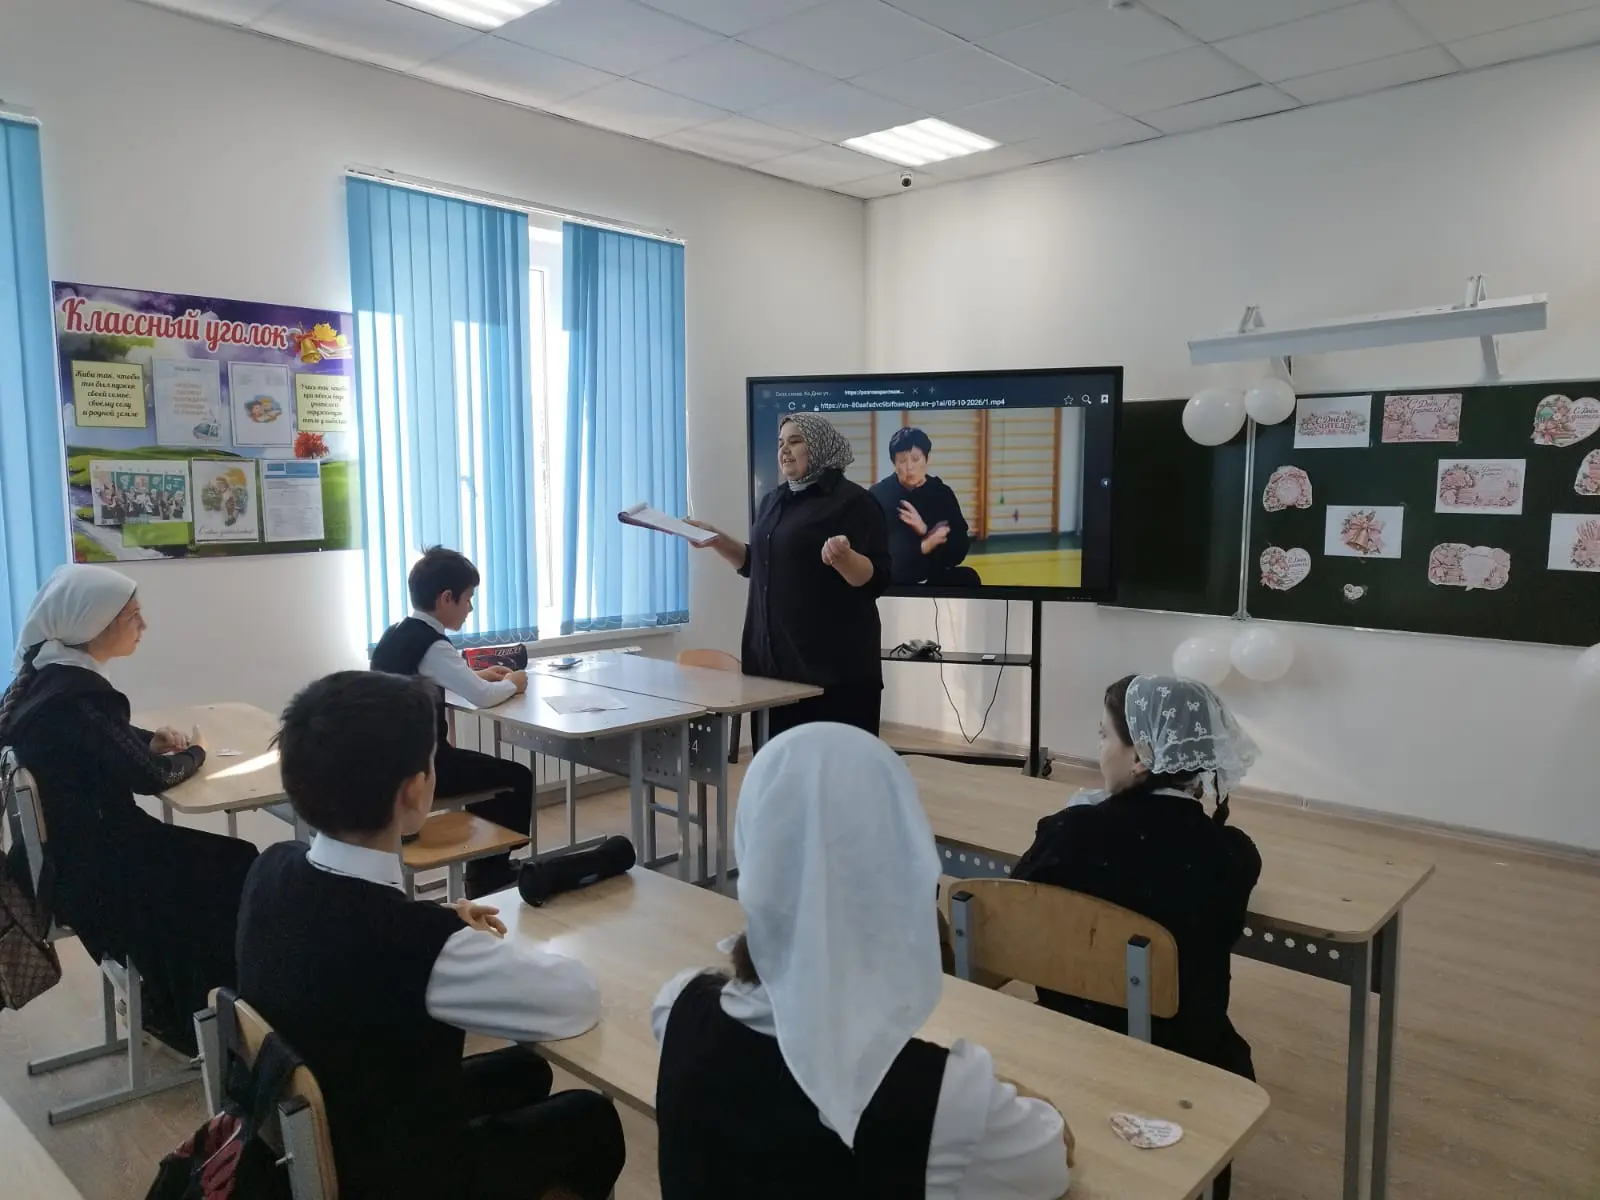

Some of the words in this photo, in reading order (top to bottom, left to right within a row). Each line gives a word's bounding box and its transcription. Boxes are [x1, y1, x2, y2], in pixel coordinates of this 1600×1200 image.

[62, 298, 200, 341] Классный
[205, 321, 288, 352] уголок
[88, 400, 115, 409] своему
[88, 410, 115, 418] родной
